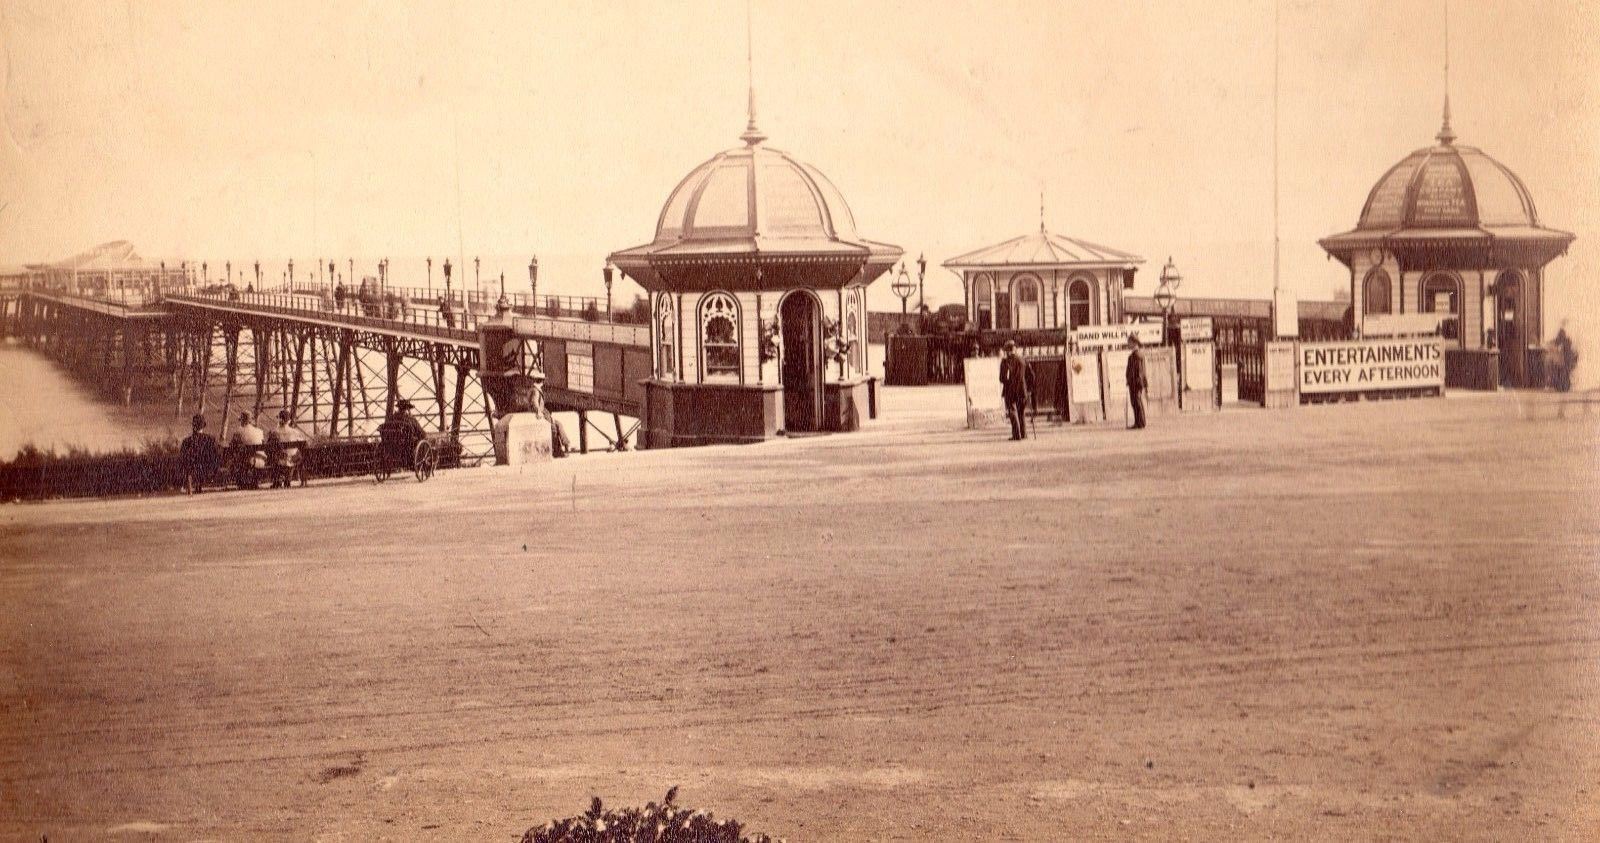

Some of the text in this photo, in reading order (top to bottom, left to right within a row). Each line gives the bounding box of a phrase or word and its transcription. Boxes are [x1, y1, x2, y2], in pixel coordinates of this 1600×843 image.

[1102, 330, 1119, 339] WILL
[1304, 343, 1441, 367] ENTERTAINMENTS
[1304, 365, 1440, 385] EVERY AFTERNOON
